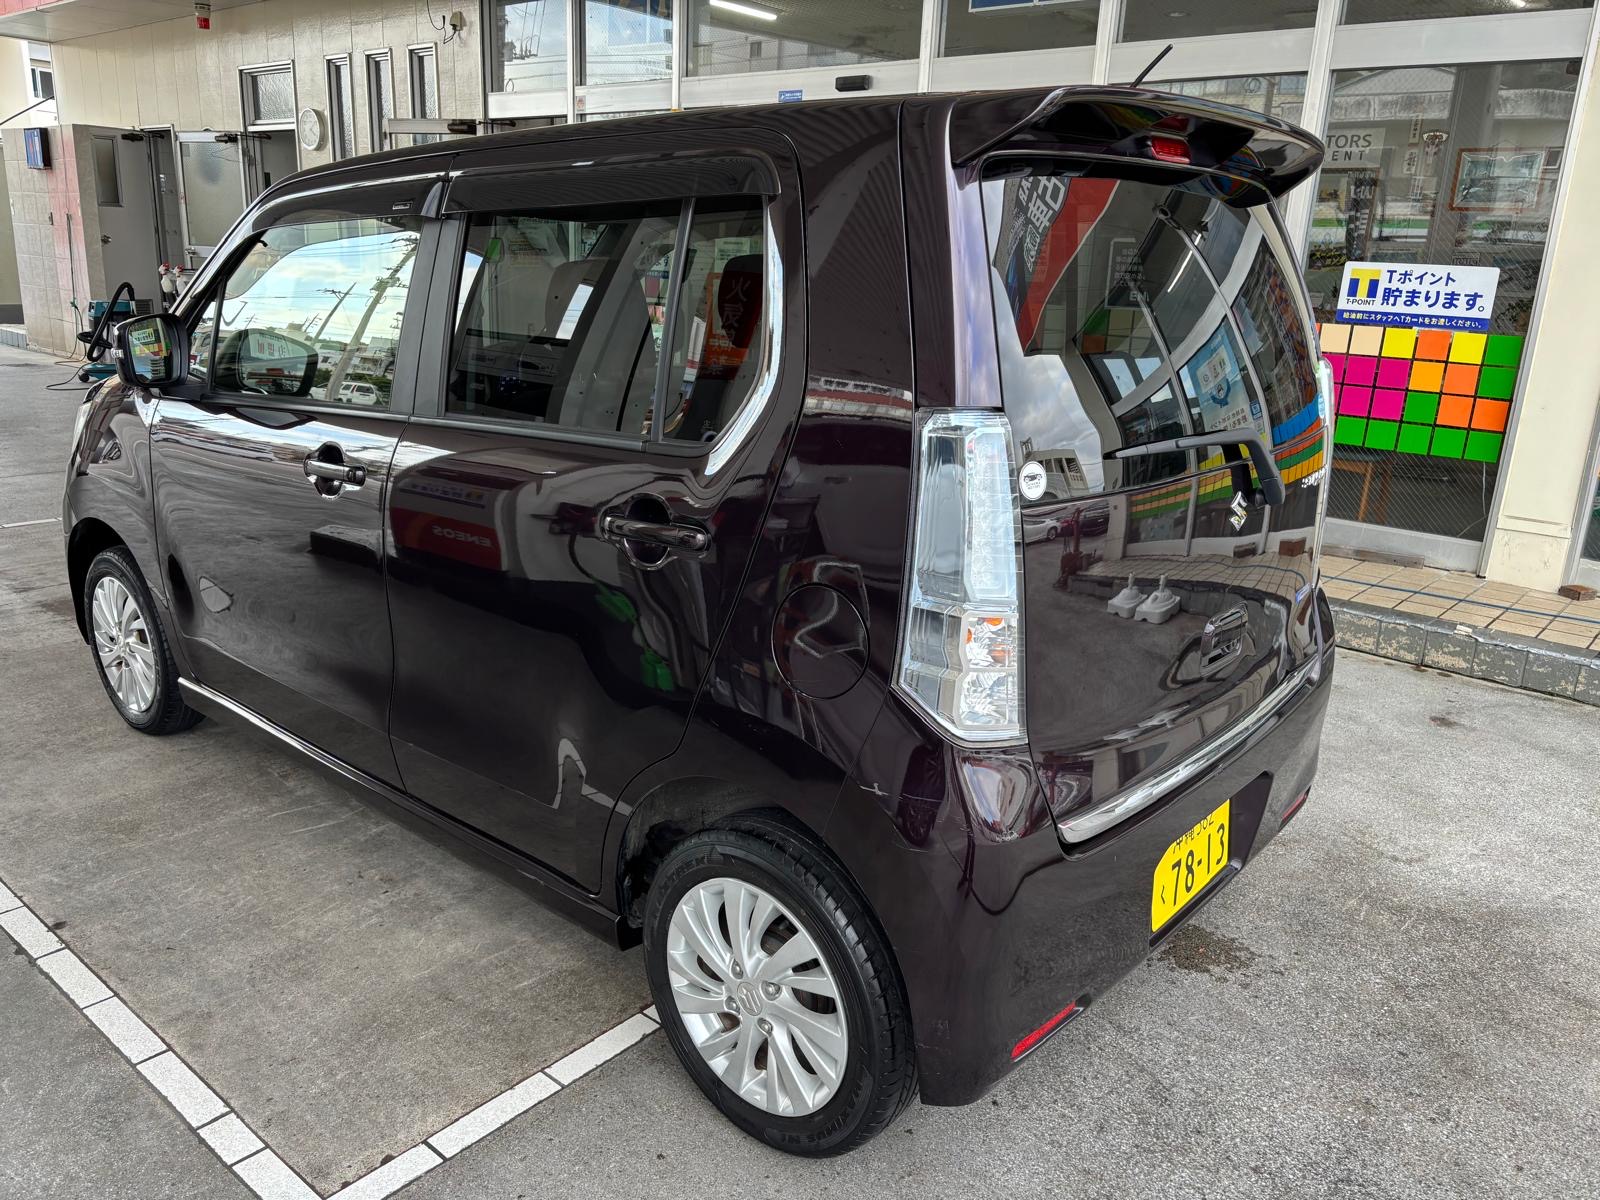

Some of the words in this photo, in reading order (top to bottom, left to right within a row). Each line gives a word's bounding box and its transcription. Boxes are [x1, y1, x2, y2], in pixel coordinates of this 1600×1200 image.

[1326, 134, 1372, 149] TORS
[1331, 150, 1365, 161] ENT
[1386, 269, 1456, 286] Tポイント
[1345, 297, 1377, 307] T-POINT
[1381, 287, 1485, 312] 貯まります。
[1171, 822, 1226, 907] 78-13
